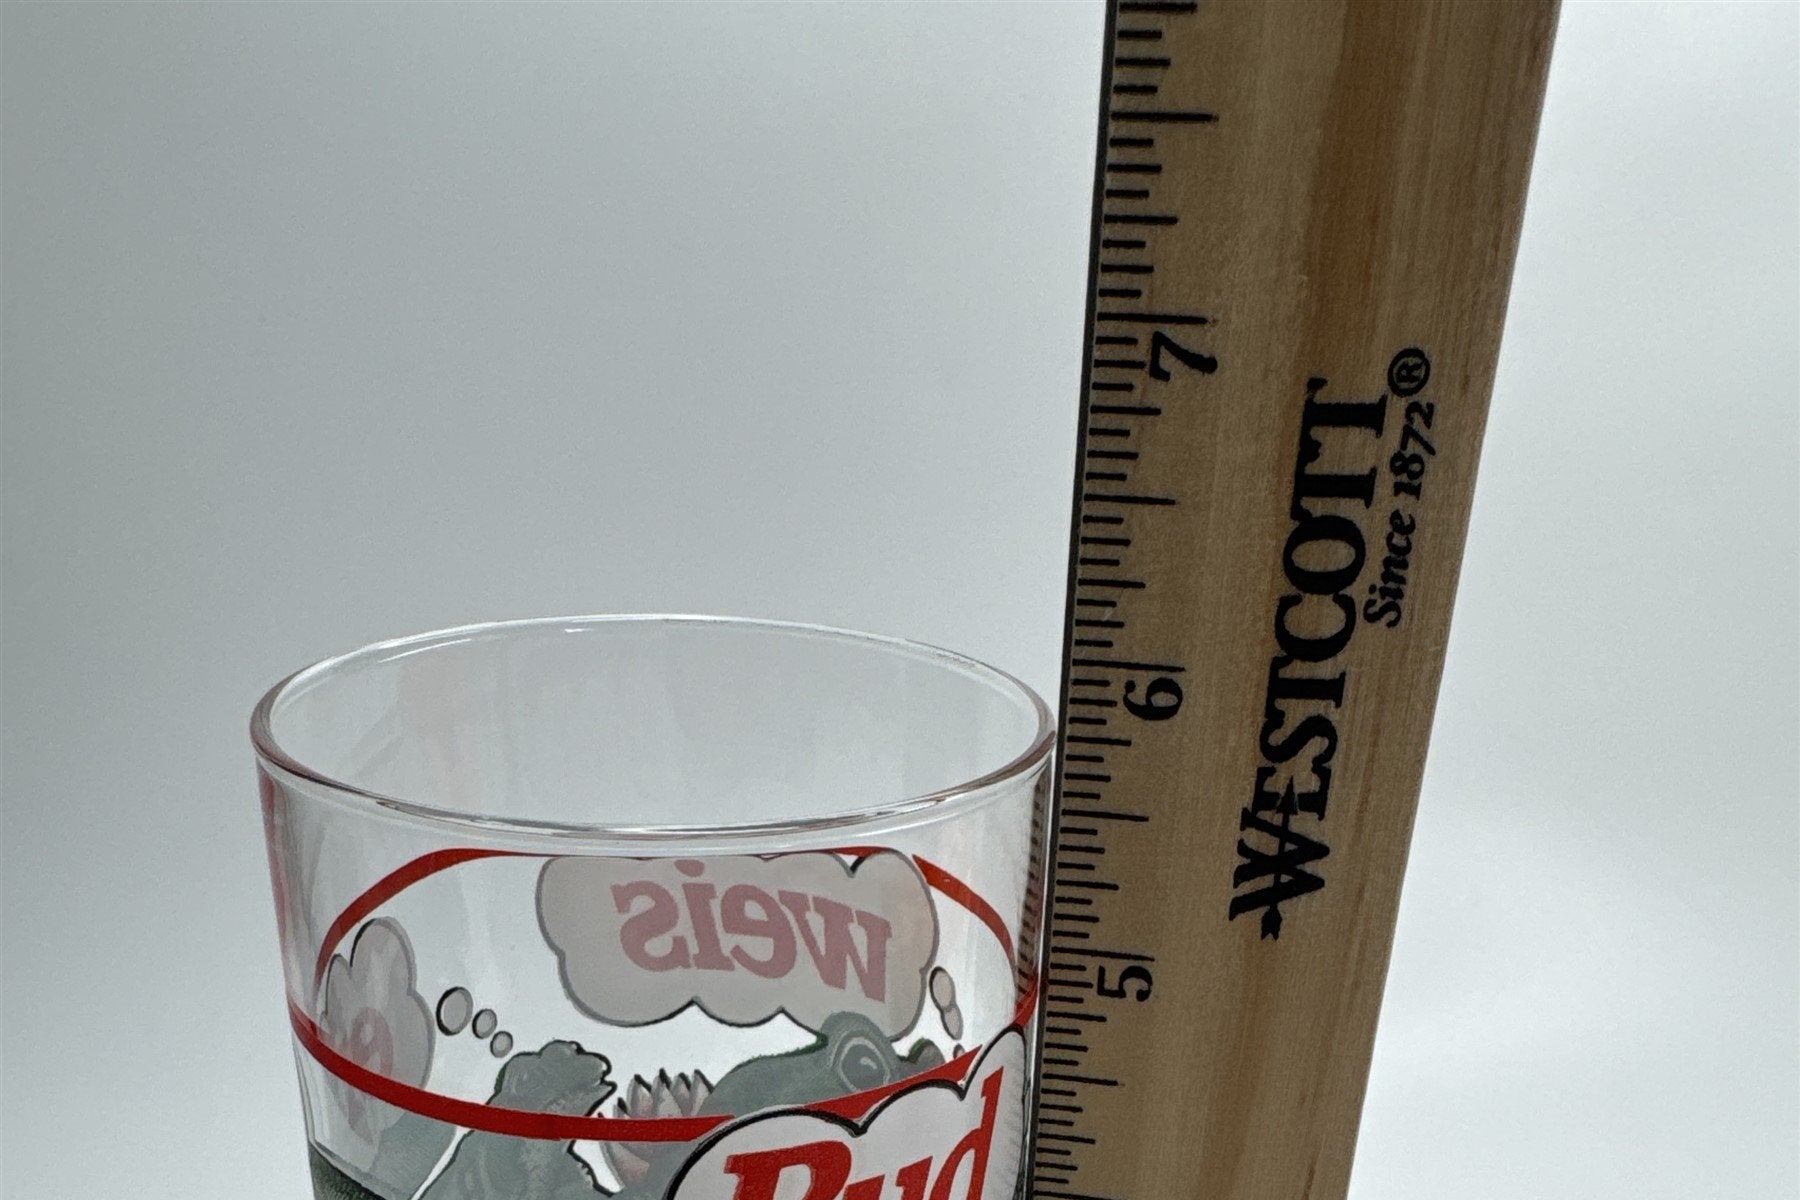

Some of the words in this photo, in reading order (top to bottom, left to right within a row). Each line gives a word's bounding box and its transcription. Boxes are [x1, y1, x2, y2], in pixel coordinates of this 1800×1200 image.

[1149, 331, 1218, 382] 7
[1364, 509, 1417, 628] Since
[1229, 376, 1390, 922] WESTCOTT
[1122, 676, 1184, 721] 6
[1097, 965, 1154, 1002] 5
